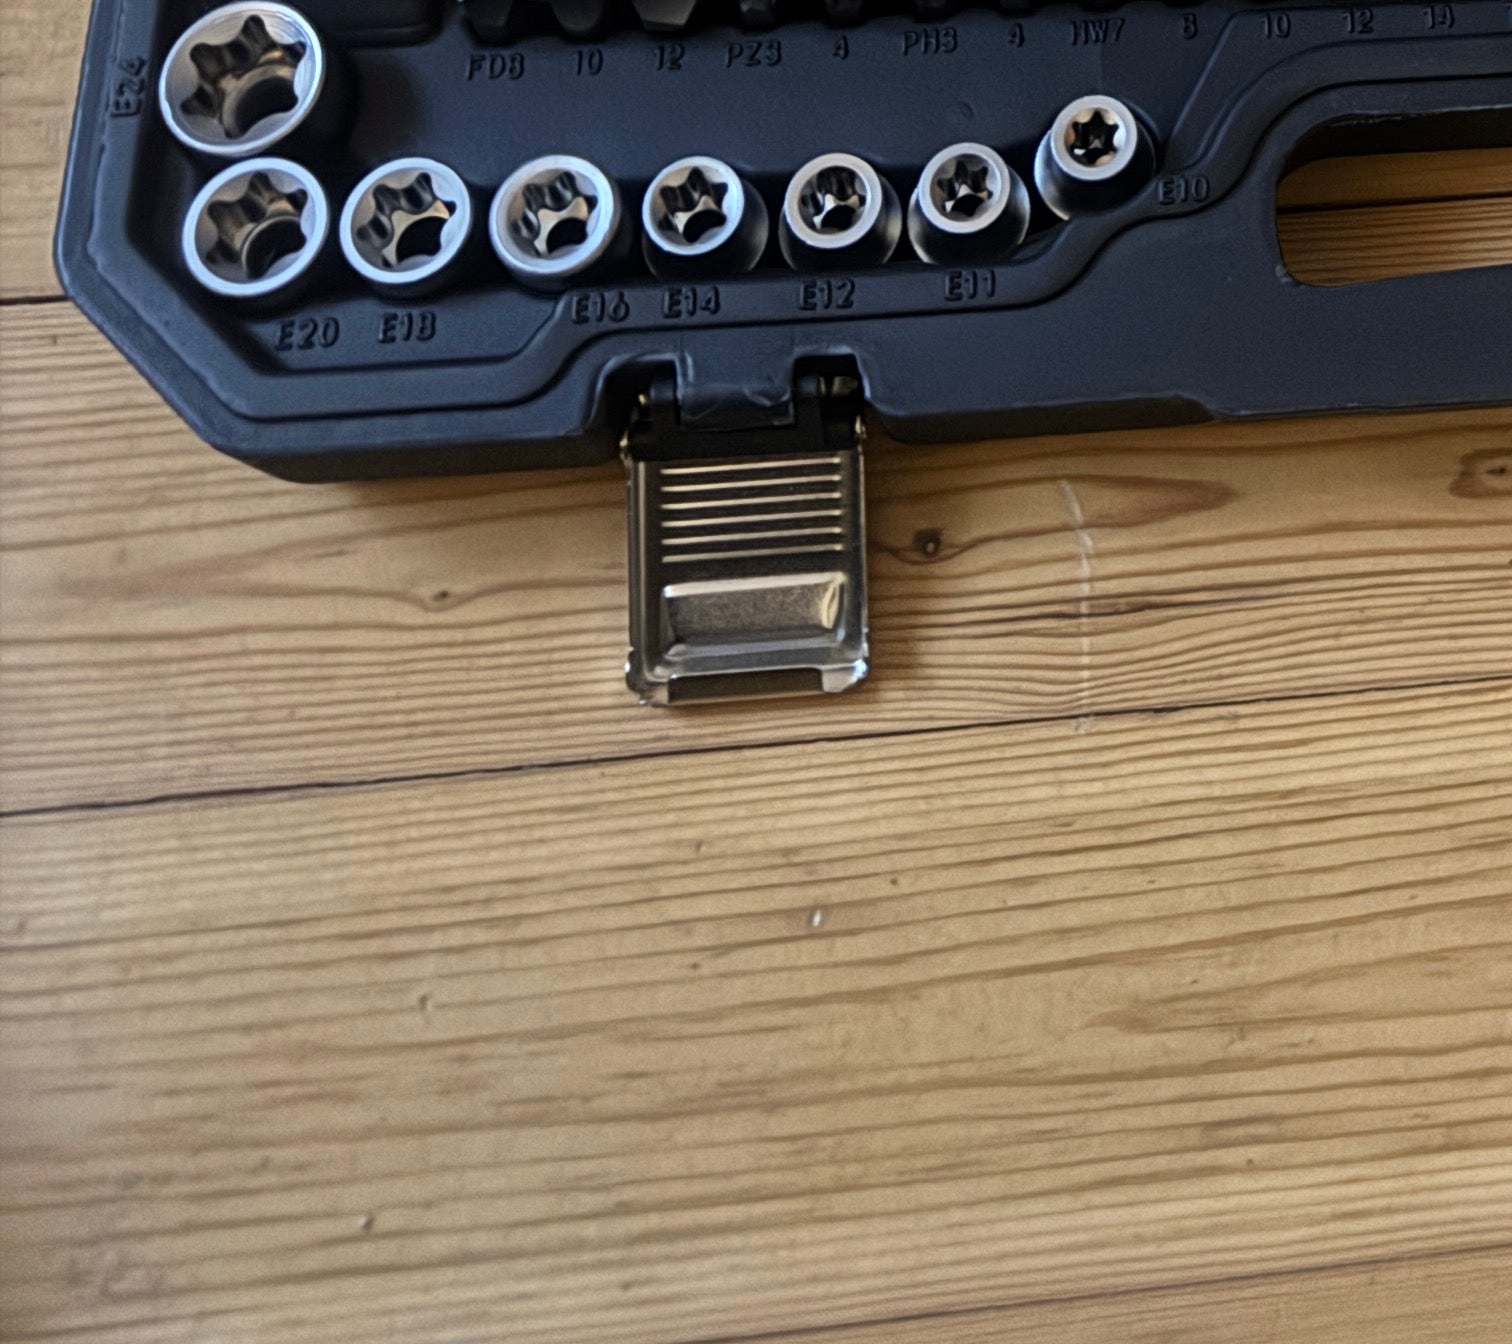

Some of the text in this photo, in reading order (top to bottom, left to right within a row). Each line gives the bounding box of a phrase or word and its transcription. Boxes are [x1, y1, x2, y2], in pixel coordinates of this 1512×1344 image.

[1070, 16, 1127, 47] HW7
[1181, 11, 1200, 41] 8
[1260, 12, 1293, 40] 10
[1342, 6, 1376, 35] 12
[1423, 4, 1456, 30] 14
[726, 39, 783, 69] PZ3
[903, 26, 959, 57] PH3
[467, 52, 526, 81] FD8
[574, 49, 605, 77] 10
[653, 43, 687, 72] 12
[109, 55, 148, 119] E24
[1156, 173, 1211, 207] E10
[798, 277, 857, 312] E12
[944, 267, 997, 303] E11
[570, 290, 631, 325] E16
[661, 285, 721, 319] E14
[274, 315, 342, 352] E20
[377, 310, 437, 344] E18
